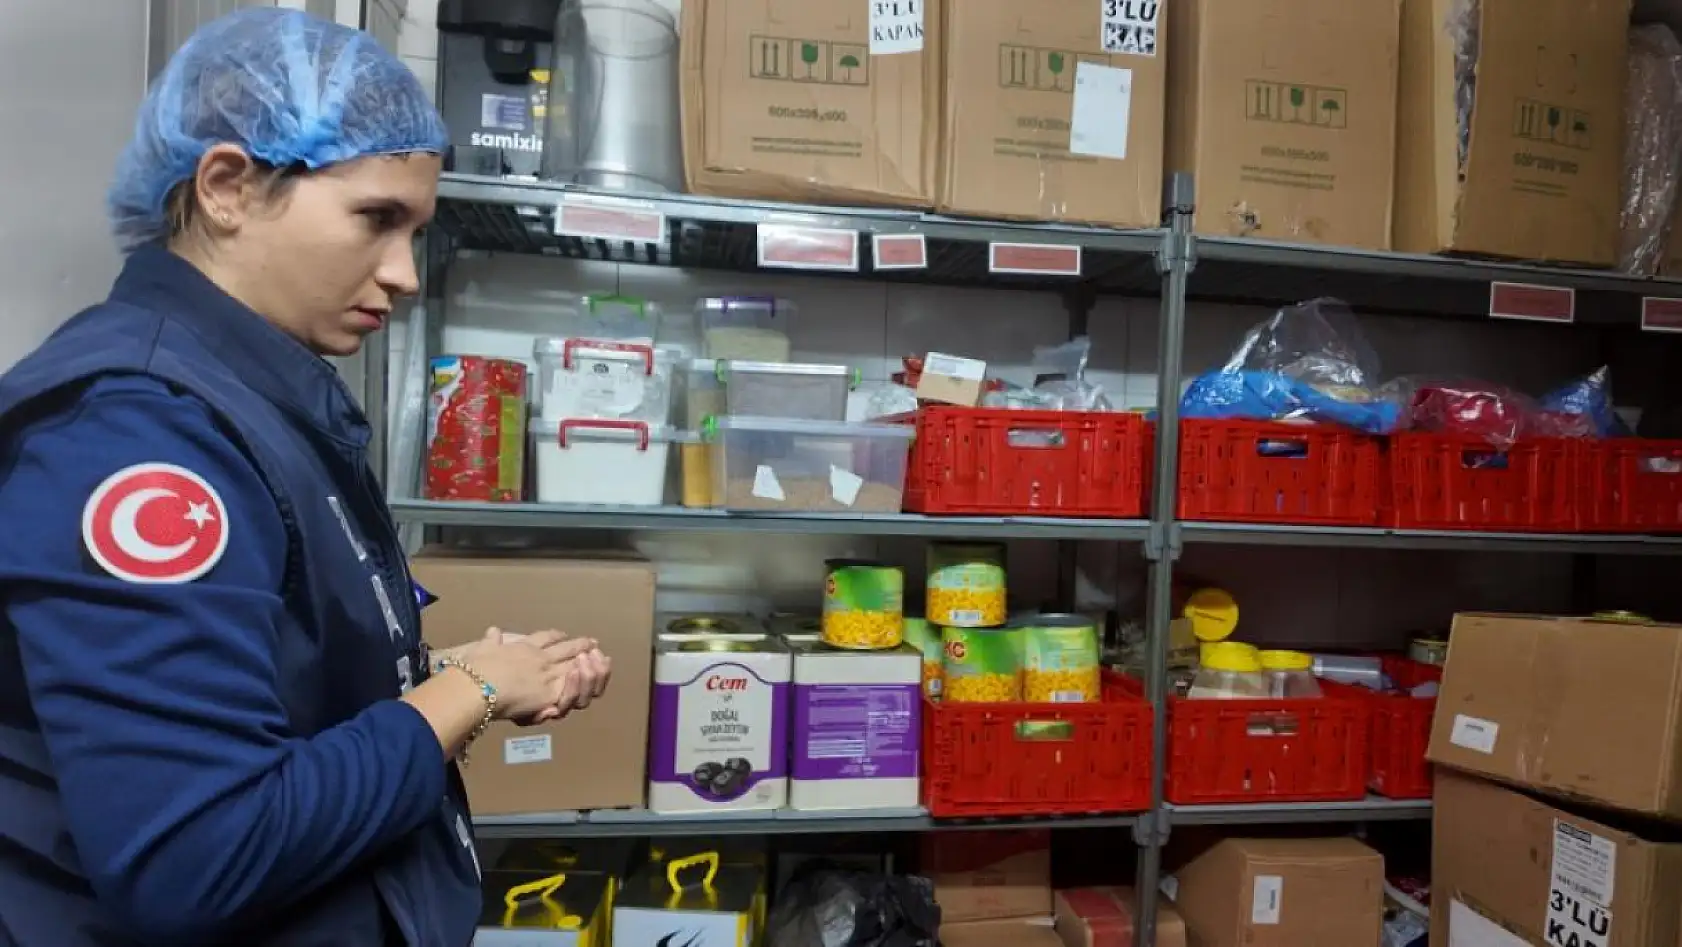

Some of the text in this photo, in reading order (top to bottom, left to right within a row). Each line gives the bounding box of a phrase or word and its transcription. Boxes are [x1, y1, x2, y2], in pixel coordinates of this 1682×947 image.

[873, 22, 924, 41] KAPAK
[706, 675, 748, 690] Cem
[1551, 888, 1609, 936] 3'LÜ
[1547, 917, 1597, 947] KA
